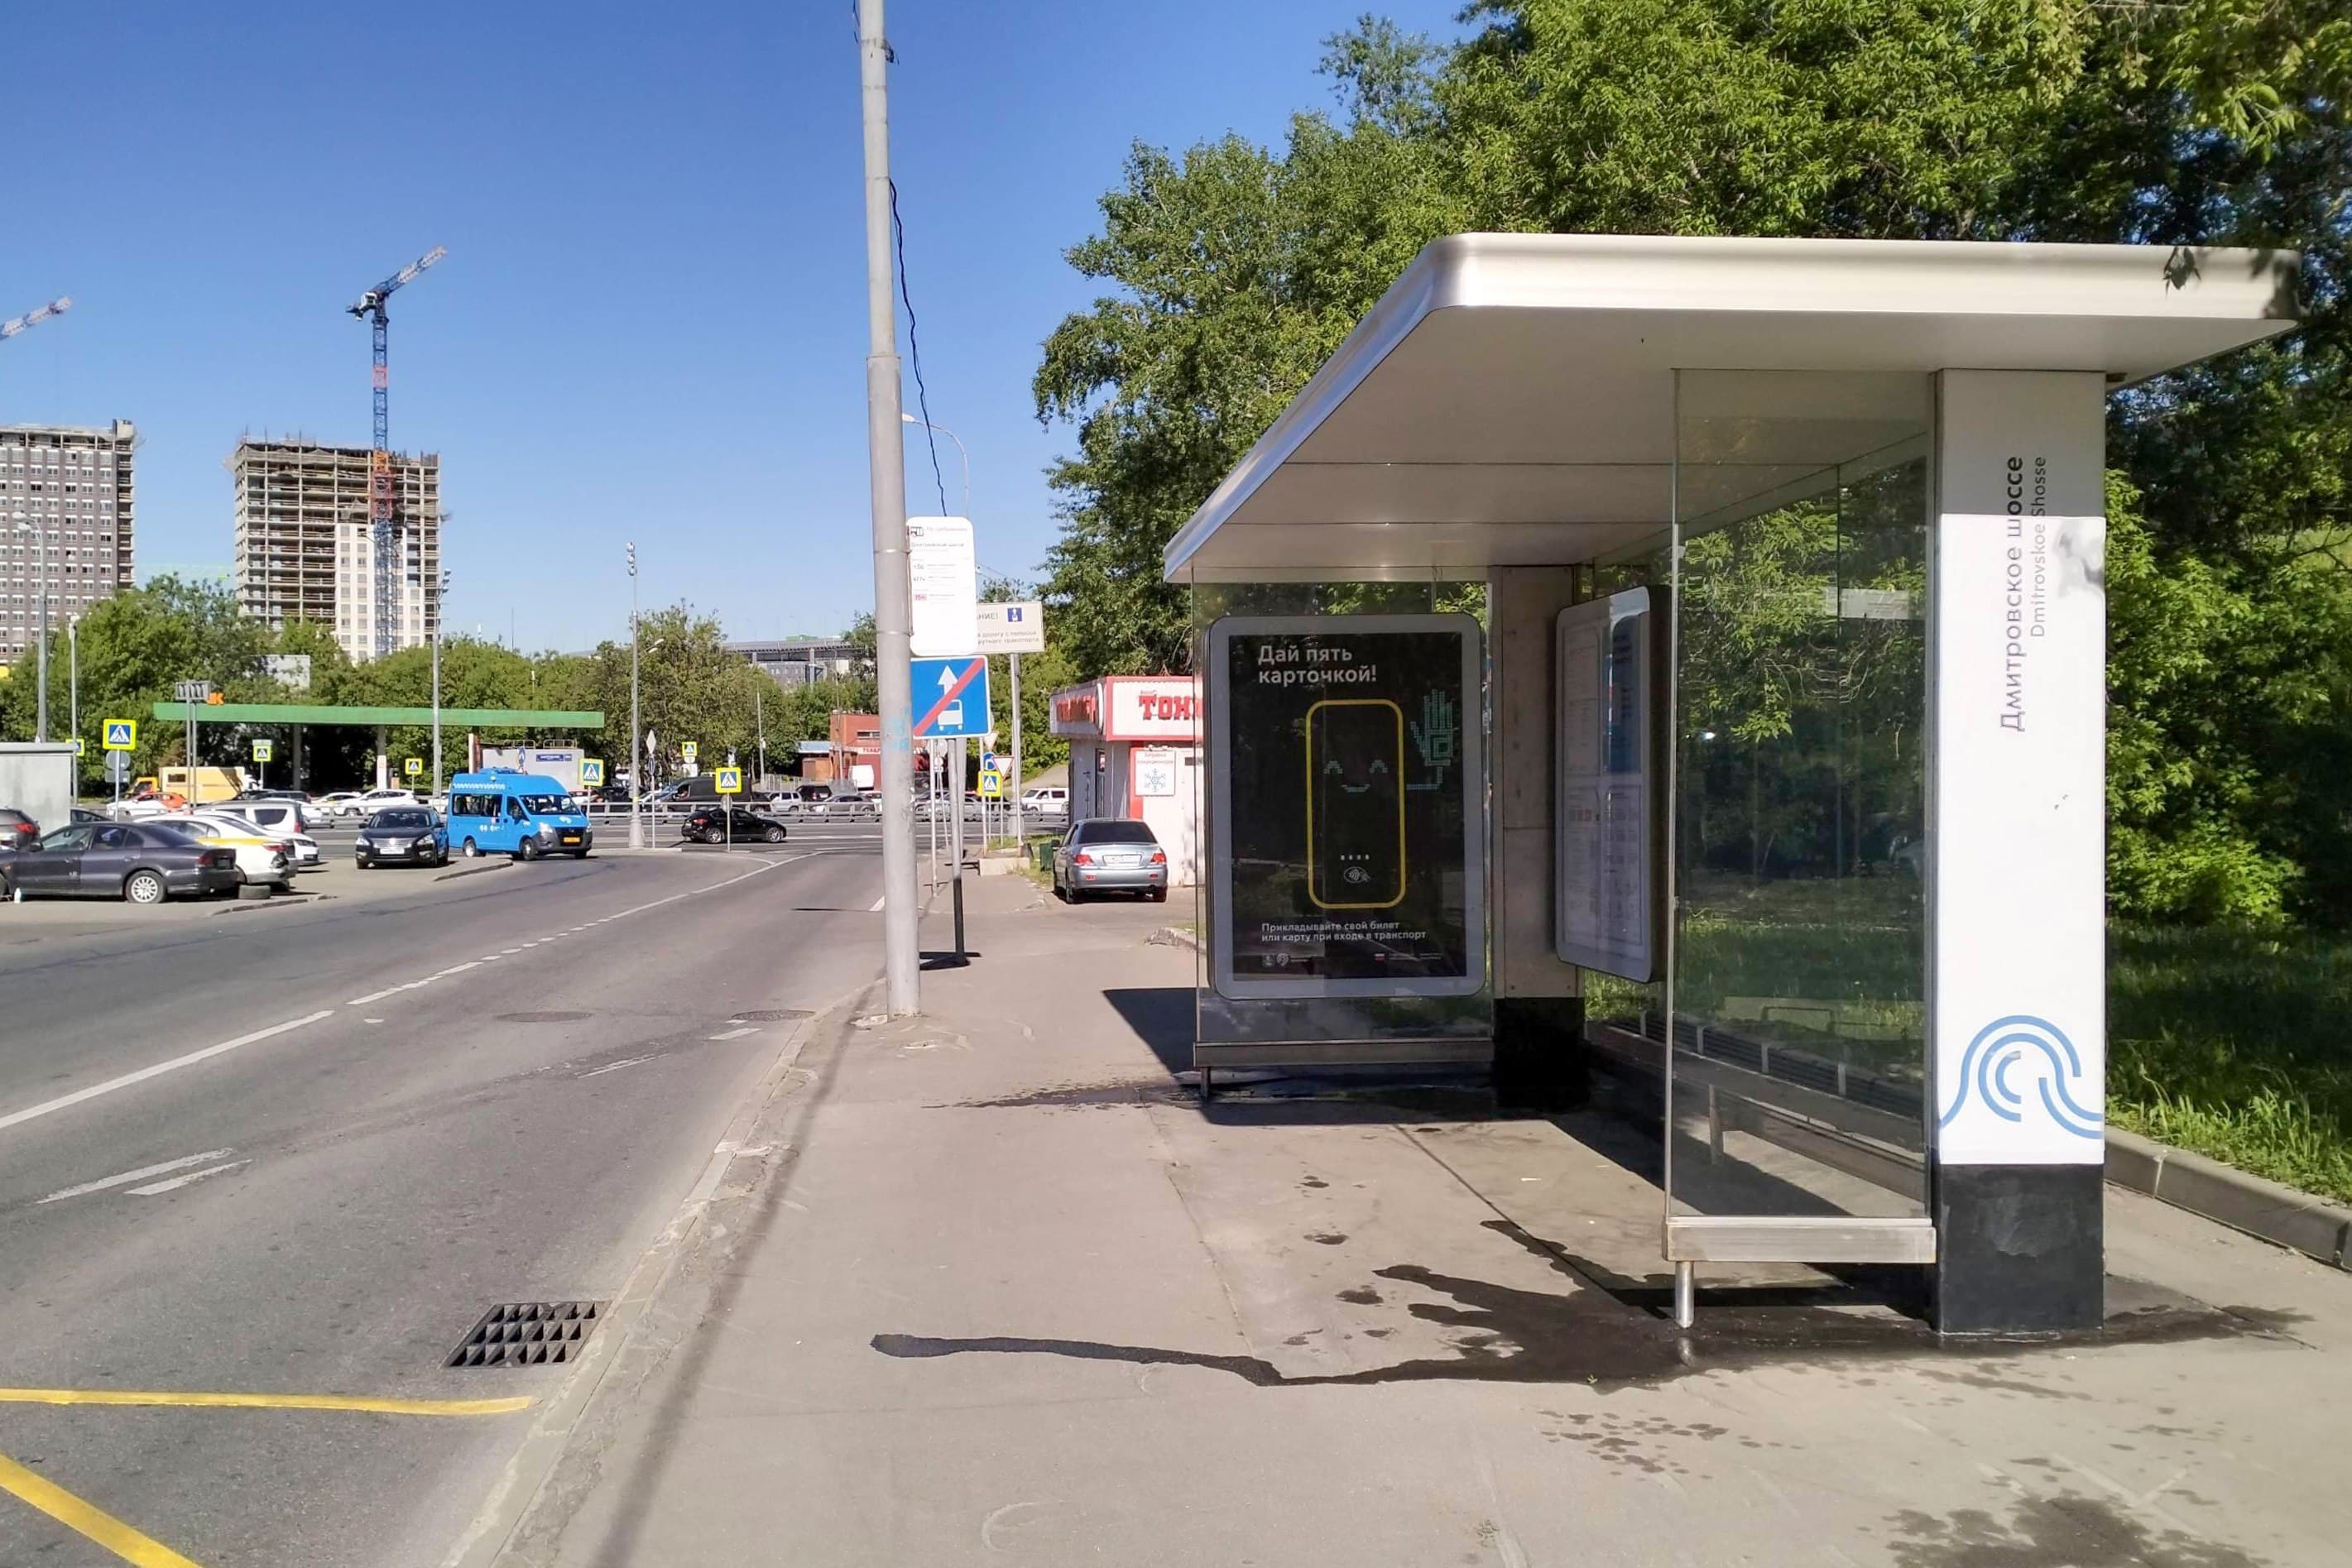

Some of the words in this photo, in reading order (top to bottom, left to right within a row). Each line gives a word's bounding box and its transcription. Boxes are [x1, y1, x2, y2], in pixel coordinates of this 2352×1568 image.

[2007, 456, 2023, 537] шоссе
[2031, 456, 2046, 518] Shosse
[2030, 524, 2046, 638] Dmitrovskoe
[1258, 645, 1300, 665] Дай
[1306, 645, 1353, 663] пять
[2000, 547, 2027, 732] Дмитровское
[1259, 664, 1378, 687] карточкой!
[1261, 922, 1342, 933] Прикладывайте
[1344, 921, 1367, 930] свой
[1370, 920, 1399, 930] билет
[1283, 934, 1311, 942] карту
[1313, 933, 1332, 942] при
[1334, 933, 1363, 942] входе
[1375, 931, 1427, 941] транспорт
